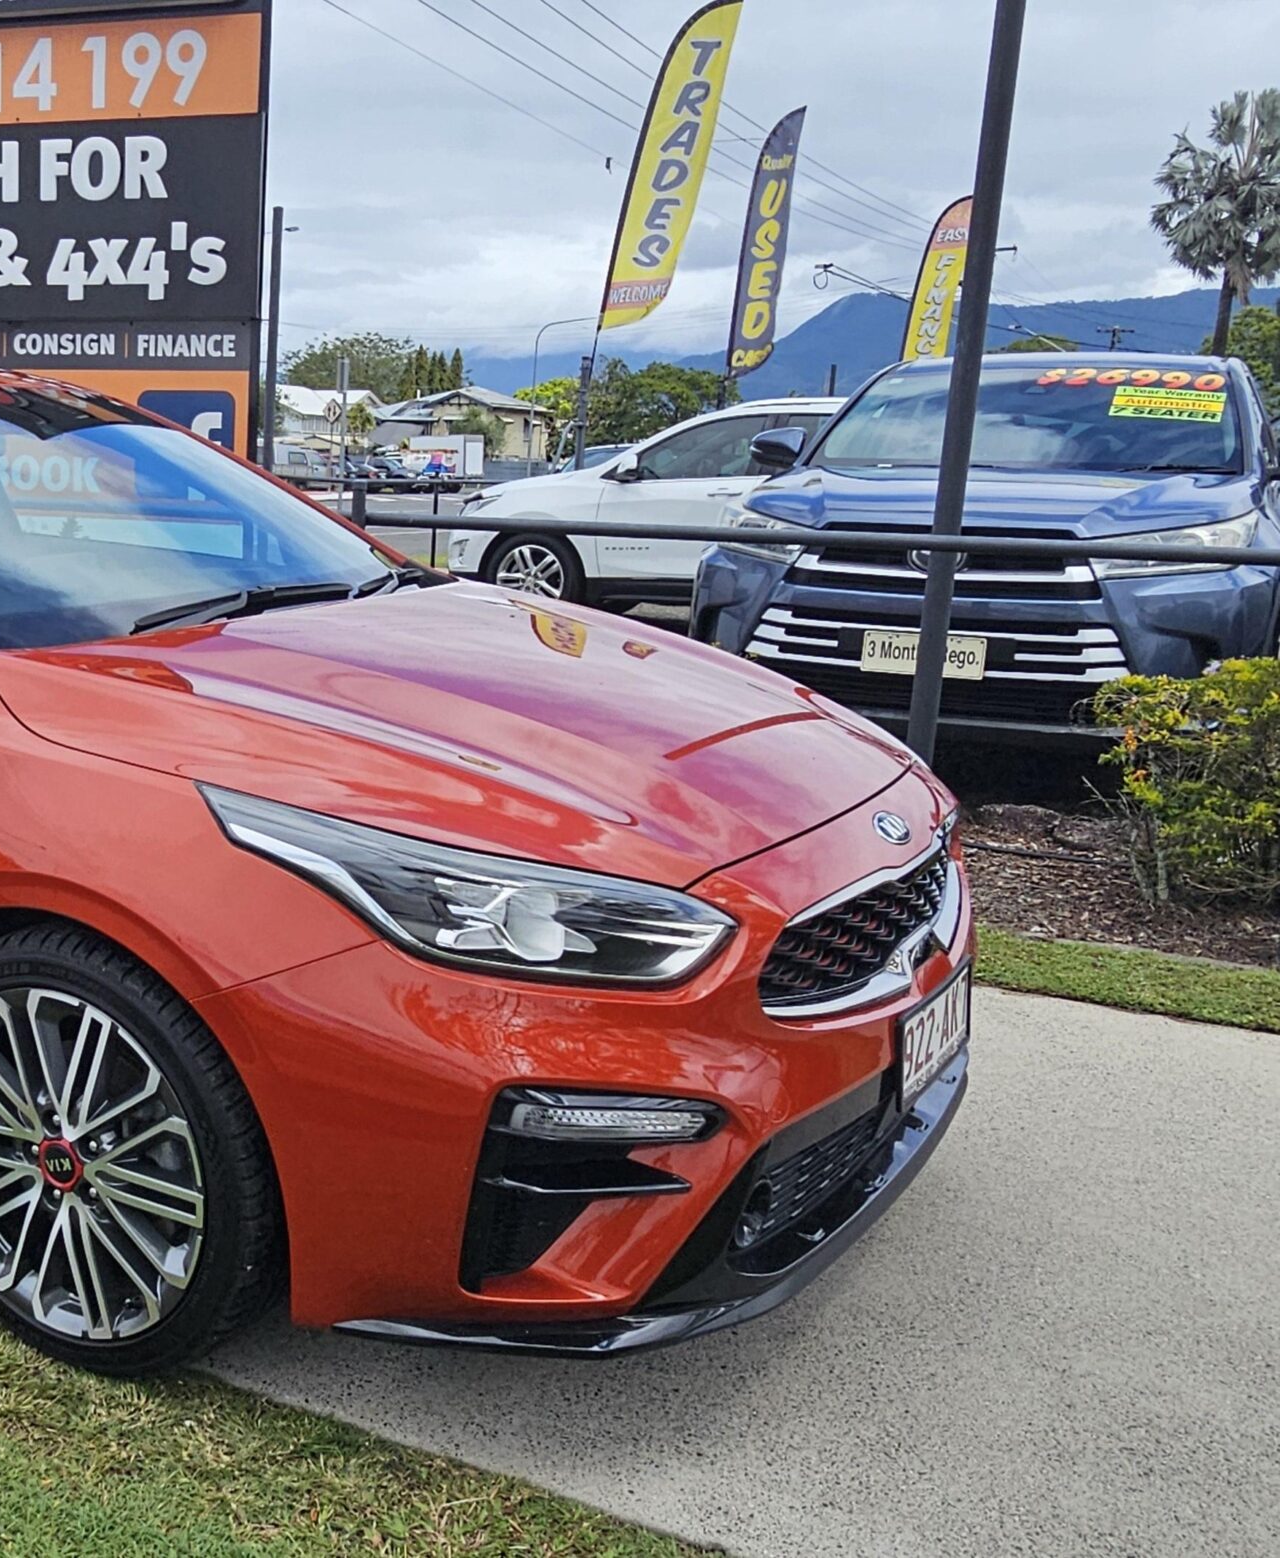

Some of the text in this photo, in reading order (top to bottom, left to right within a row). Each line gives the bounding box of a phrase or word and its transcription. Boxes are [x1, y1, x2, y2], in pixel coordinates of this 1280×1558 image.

[81, 29, 207, 109] 199
[39, 135, 169, 201] FOR
[631, 40, 722, 269] TRADES
[740, 178, 788, 341] USED
[914, 254, 957, 359] FINANC
[13, 333, 116, 357] CONSIGN
[137, 334, 236, 358] FINANCE
[1036, 368, 1226, 391] $26990
[1124, 397, 1213, 409] Automatic
[1165, 390, 1224, 400] Warranty
[1130, 407, 1219, 420] SEATER
[867, 640, 980, 669] 3 Mont ego.
[45, 1157, 72, 1172] KIA
